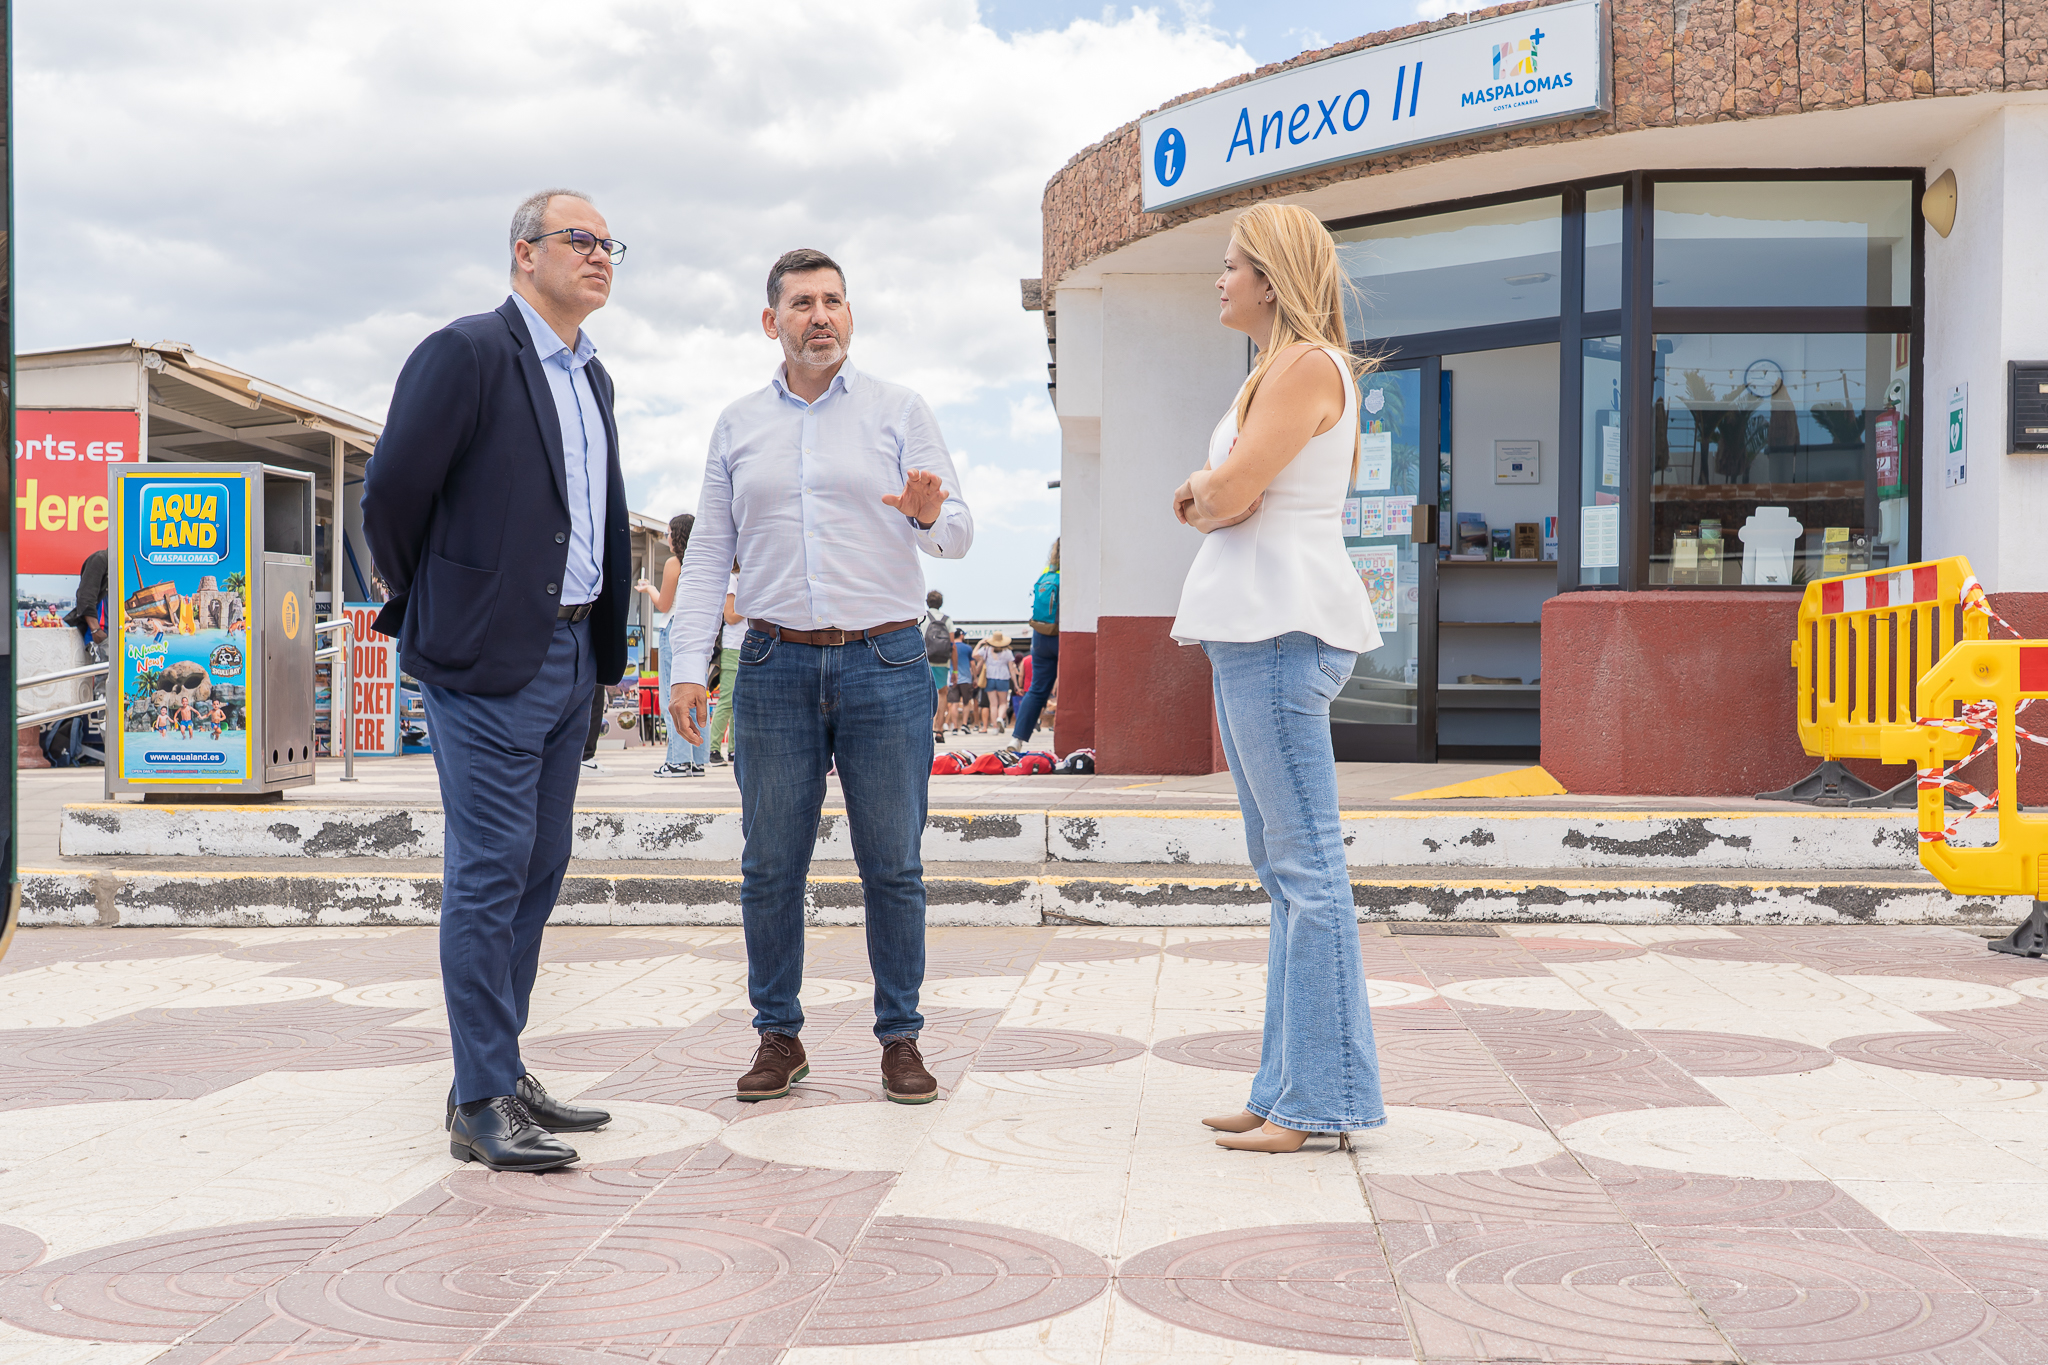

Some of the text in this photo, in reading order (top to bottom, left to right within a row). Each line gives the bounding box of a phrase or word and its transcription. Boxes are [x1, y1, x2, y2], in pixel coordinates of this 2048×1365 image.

[1461, 72, 1573, 107] MASPALOMAS
[1493, 99, 1539, 112] COSTA CANARIA
[1226, 89, 1370, 162] Anexo
[15, 479, 108, 532] Here
[150, 494, 217, 522] AQUA
[150, 520, 217, 548] LAND
[153, 554, 214, 562] MASPALOMAS
[344, 610, 389, 642] OO
[137, 655, 164, 673] New!
[212, 668, 241, 676] SKULL BAY
[344, 646, 387, 678] OUR
[344, 682, 394, 714] CKET
[344, 719, 385, 750] ERE
[150, 753, 219, 762] www.aqualand.es
